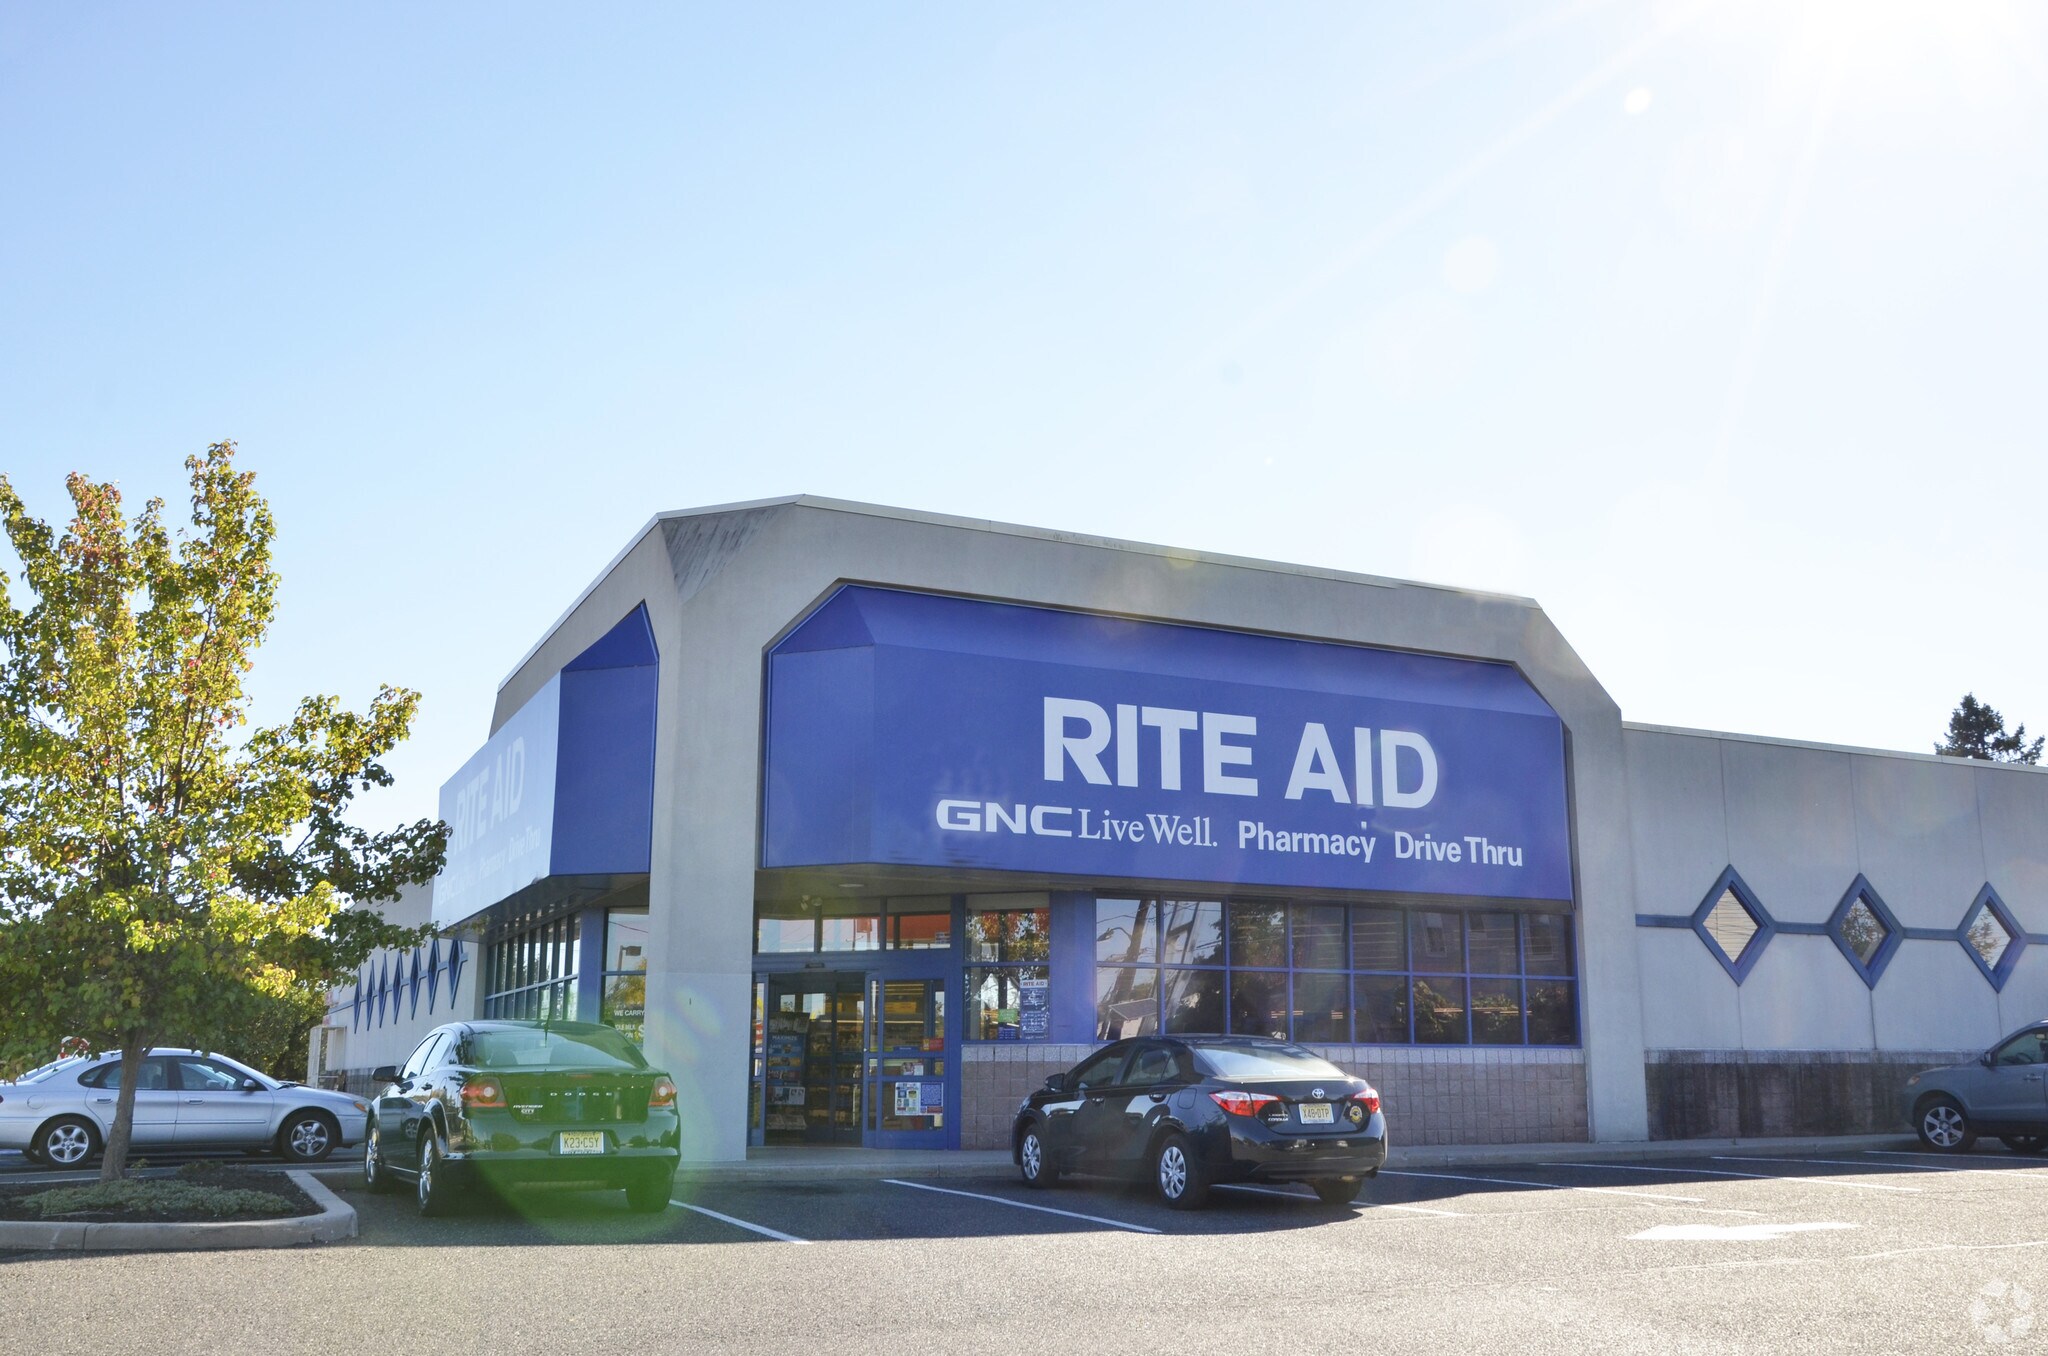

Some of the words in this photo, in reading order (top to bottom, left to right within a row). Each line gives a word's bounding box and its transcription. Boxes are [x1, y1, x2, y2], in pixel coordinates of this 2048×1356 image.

[455, 765, 490, 856] RITE
[491, 736, 525, 830] AID
[1043, 696, 1258, 797] RITE
[1284, 722, 1438, 809] AID
[936, 799, 1073, 838] GNC
[1238, 820, 1376, 863] Pharmacy
[1394, 831, 1462, 863] Drive
[1463, 836, 1524, 867] Thru
